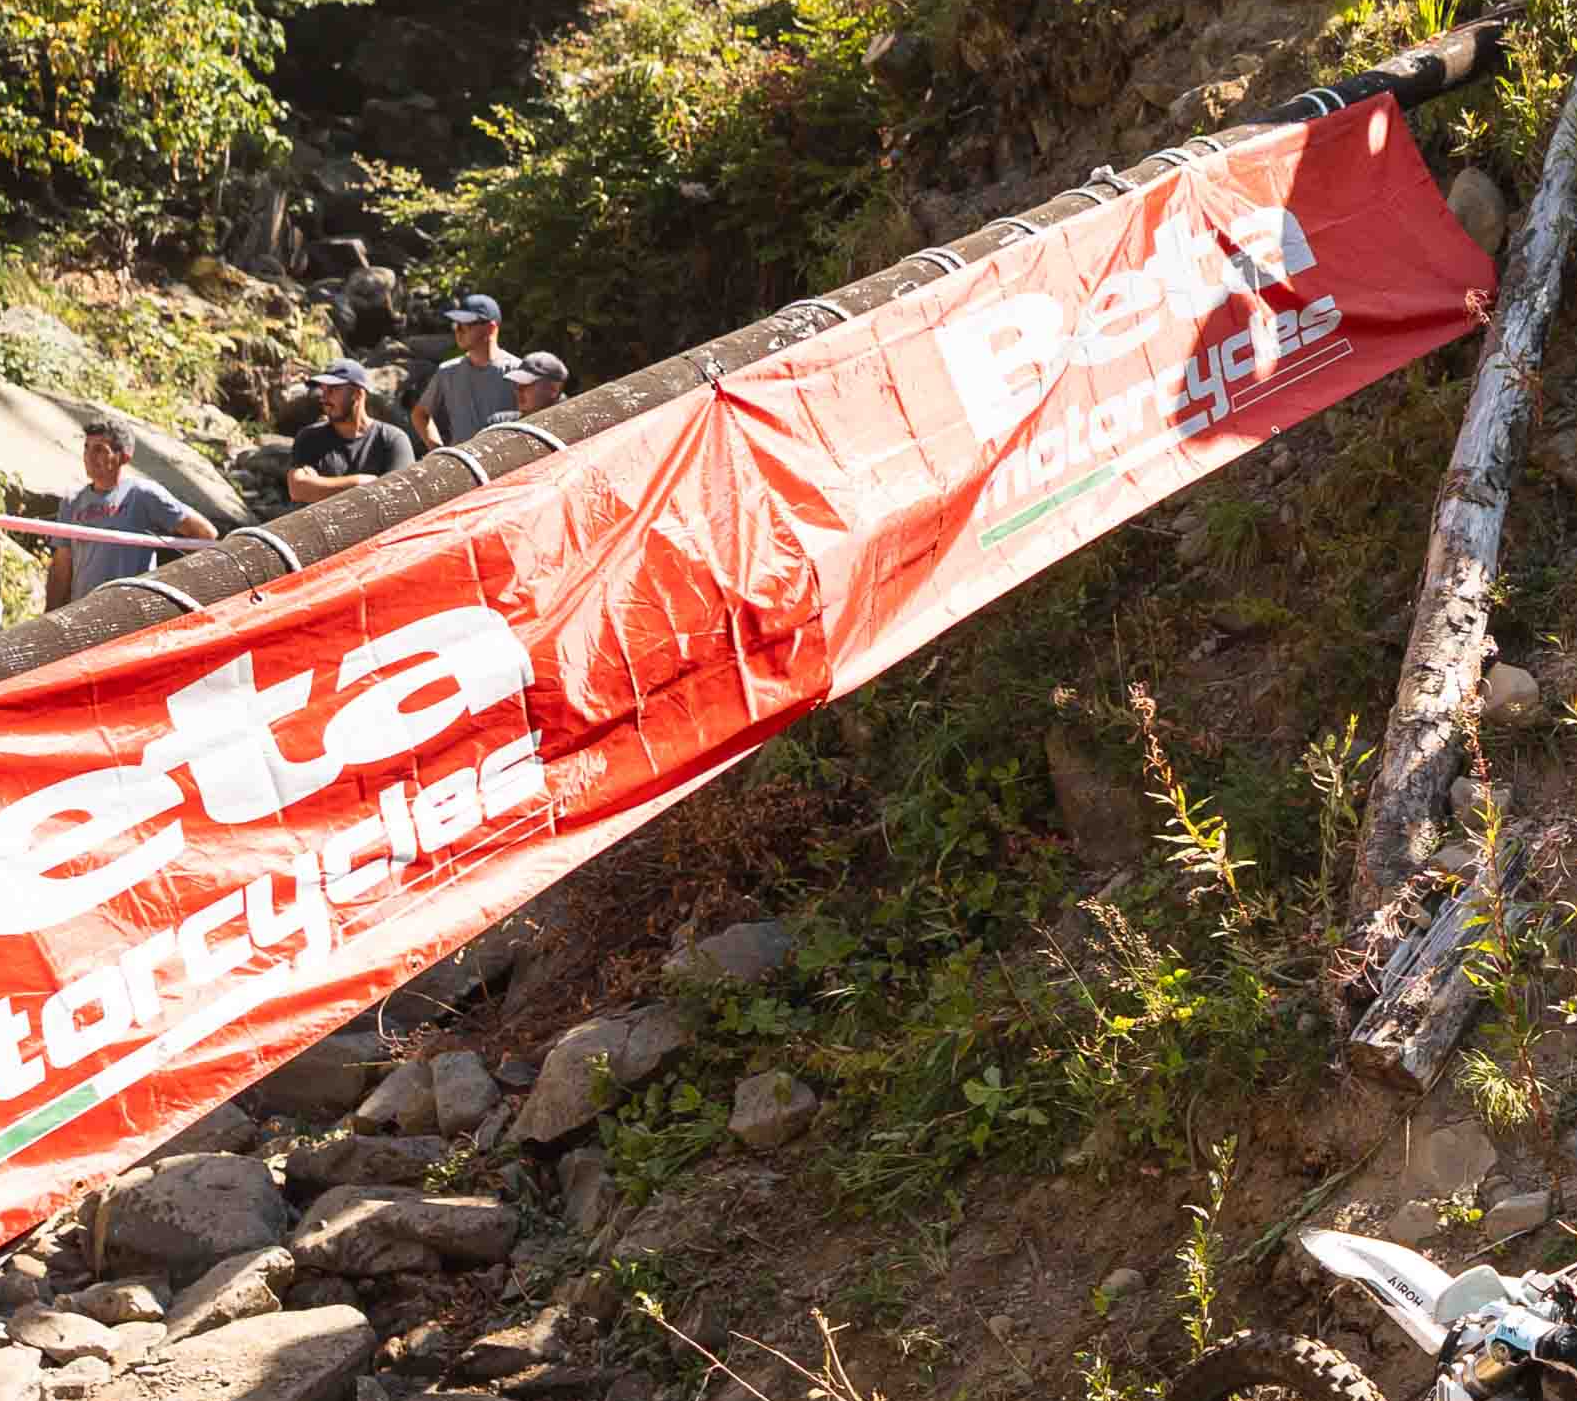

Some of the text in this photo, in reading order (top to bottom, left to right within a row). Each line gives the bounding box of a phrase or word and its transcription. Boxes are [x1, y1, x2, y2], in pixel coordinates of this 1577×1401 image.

[934, 207, 1317, 441] Beta
[978, 295, 1343, 518] motorcycles
[1387, 1276, 1424, 1308] AIROH
